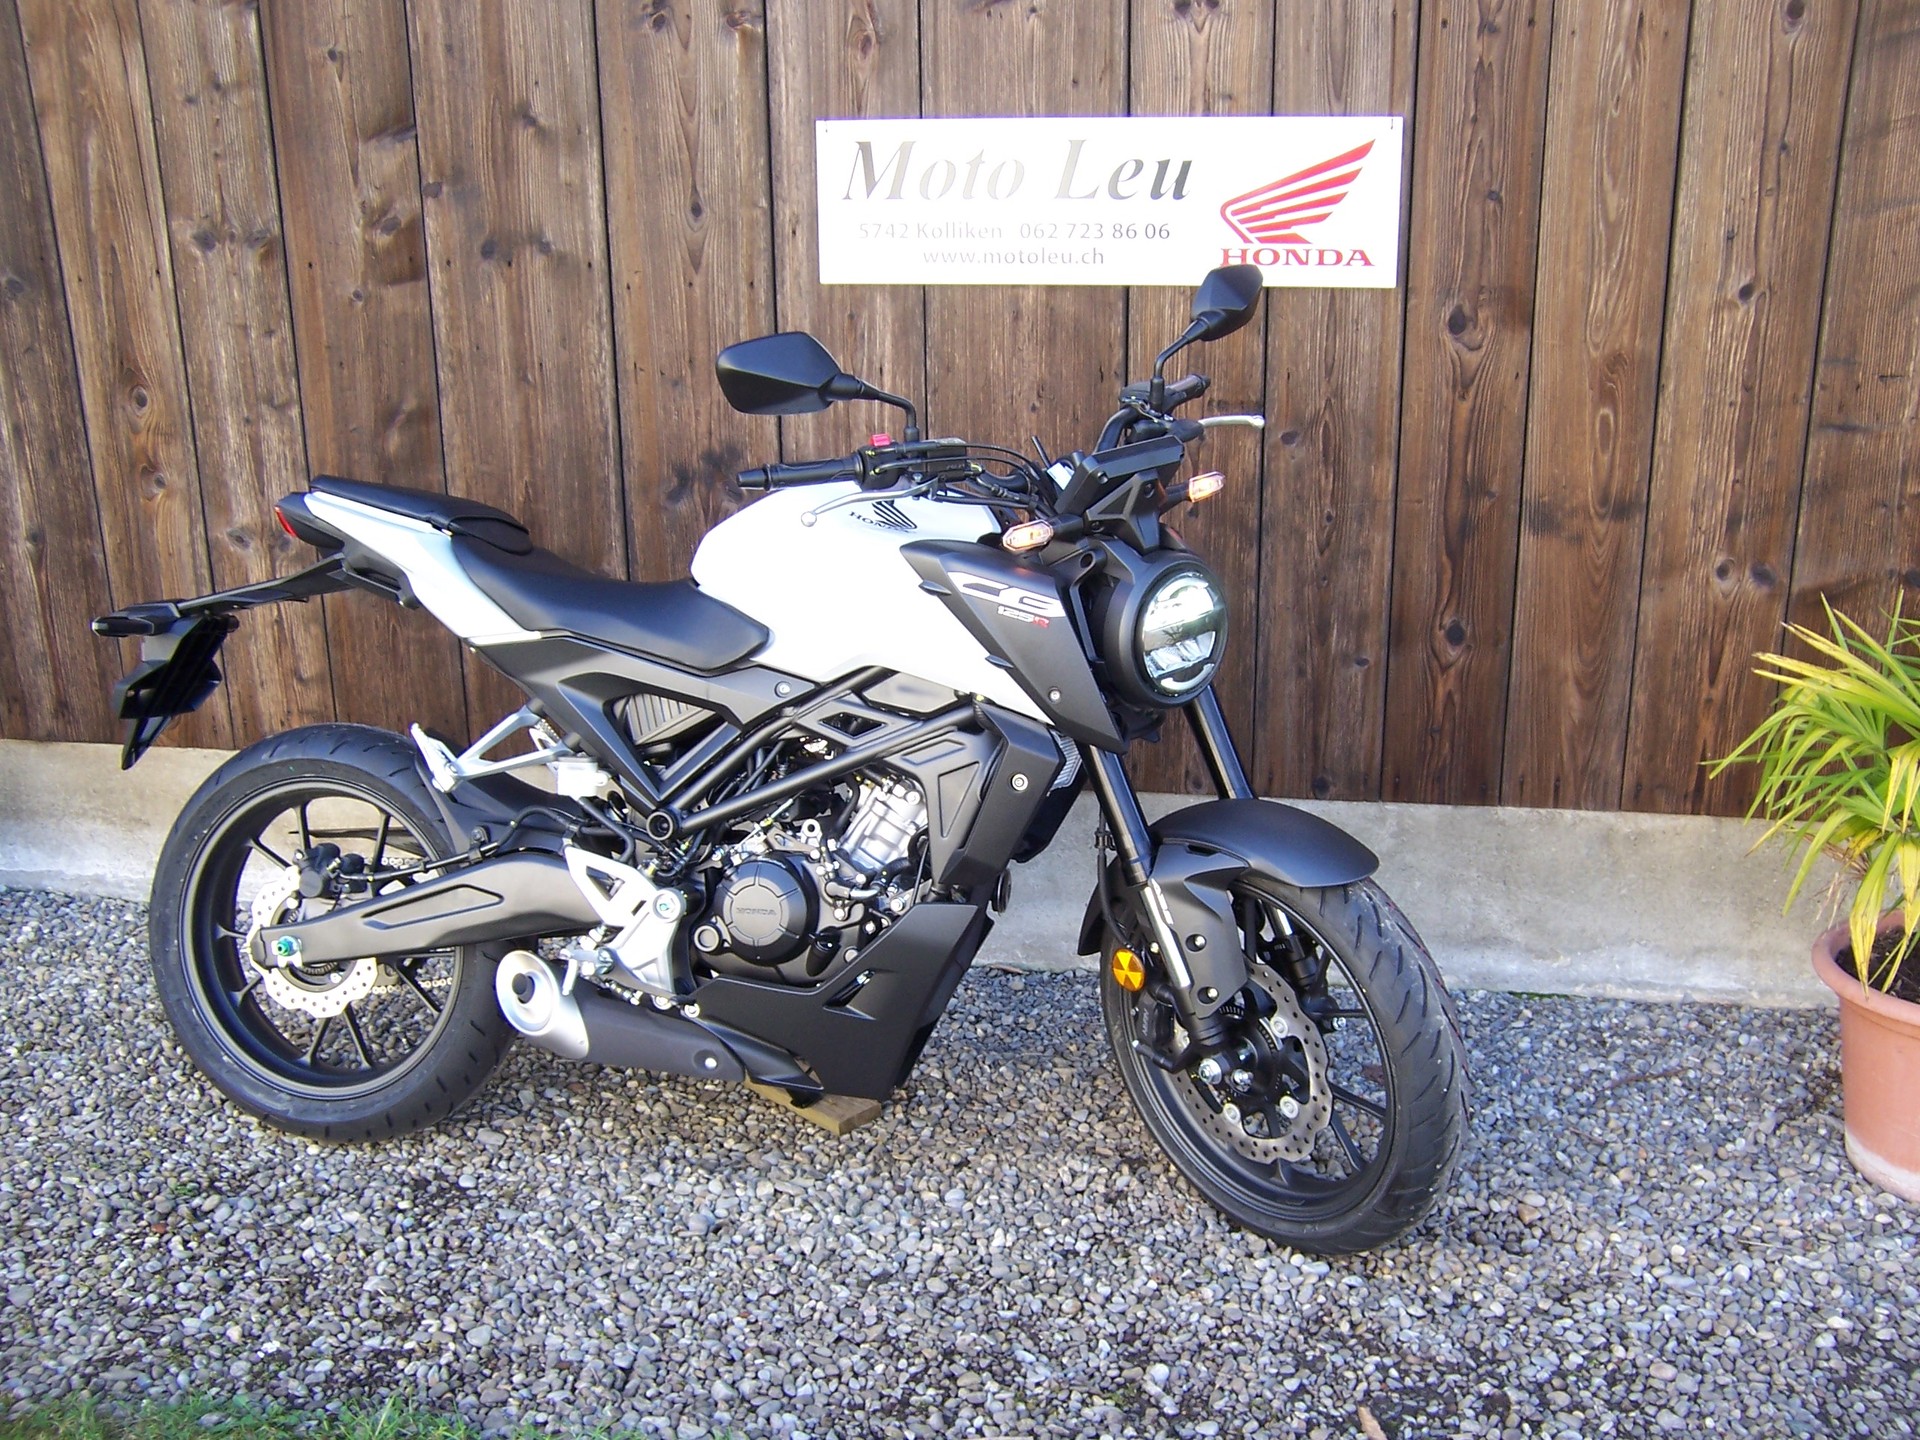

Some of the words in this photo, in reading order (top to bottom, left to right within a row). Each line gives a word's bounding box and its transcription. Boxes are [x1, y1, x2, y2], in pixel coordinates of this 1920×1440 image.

[843, 140, 1025, 201] Moto
[1053, 139, 1193, 201] Leu
[858, 222, 909, 239] 5742
[1020, 222, 1058, 240] 062
[1066, 222, 1104, 240] 723
[1112, 222, 1138, 240] 86
[1144, 222, 1171, 240] 06
[922, 247, 1105, 265] www.motoleu.ch
[1220, 248, 1376, 267] HONDA
[735, 907, 777, 916] HONDA
